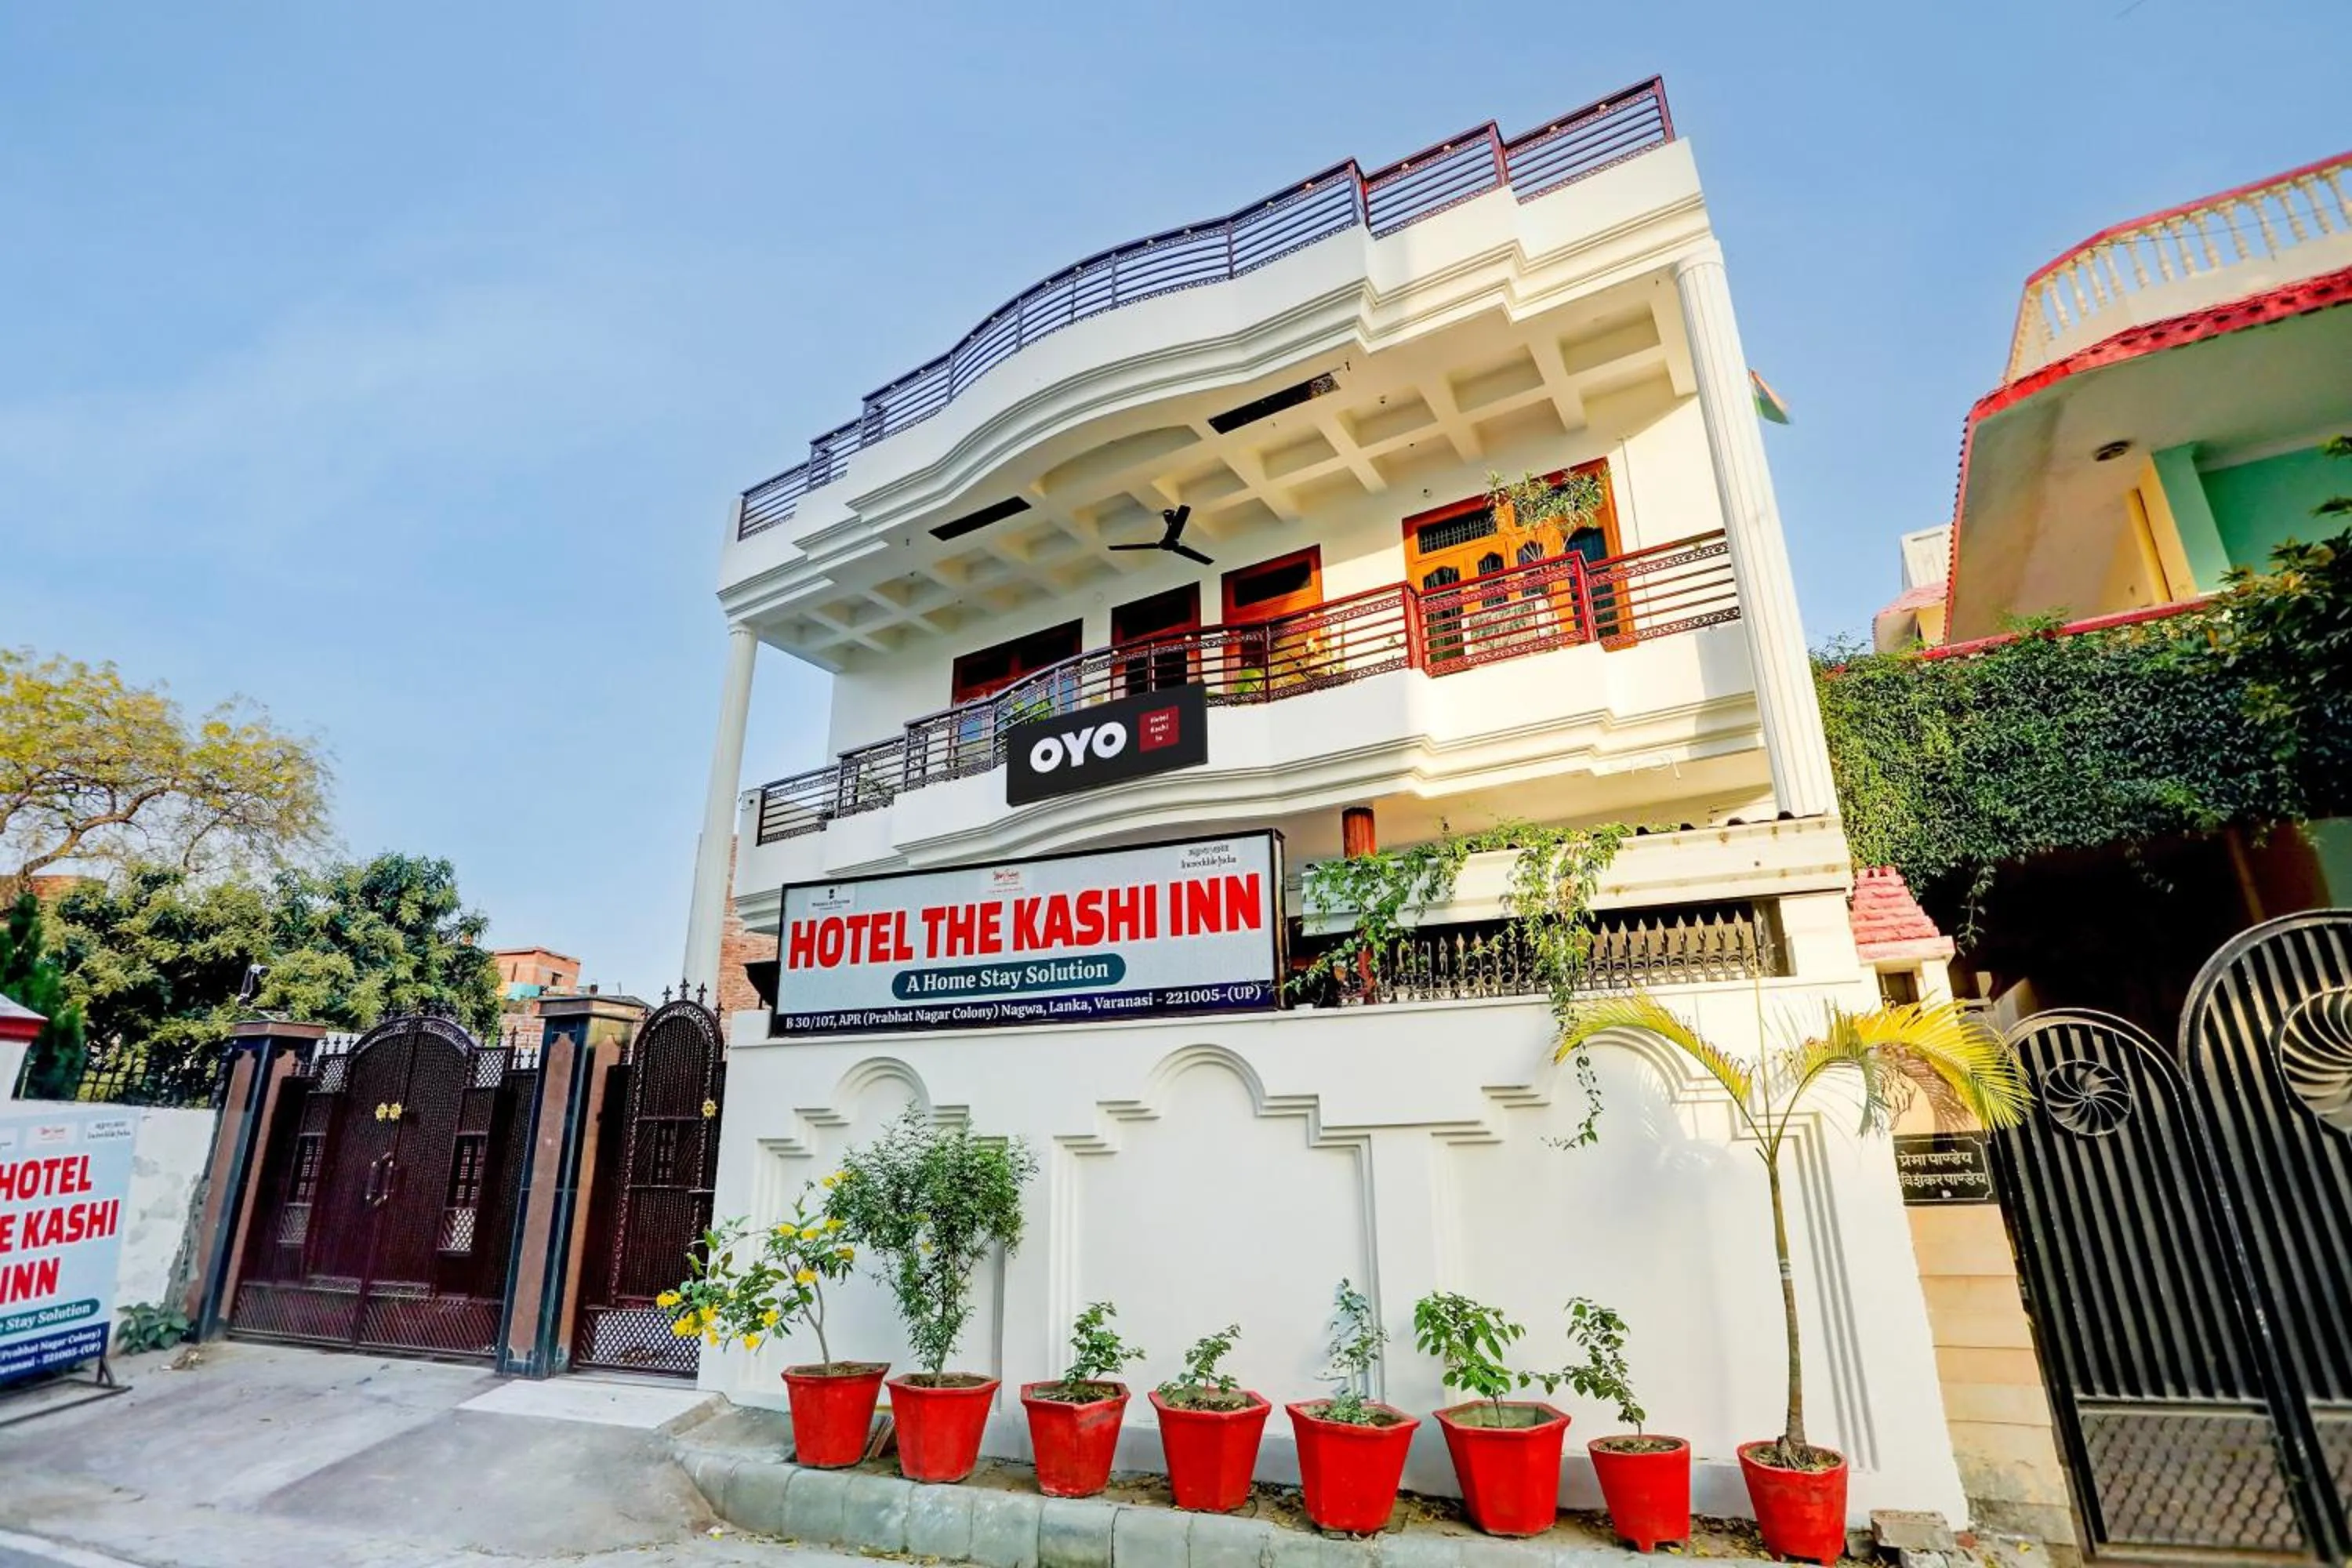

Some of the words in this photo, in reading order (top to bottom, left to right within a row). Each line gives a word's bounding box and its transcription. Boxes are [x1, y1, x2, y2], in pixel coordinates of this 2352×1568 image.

[1029, 721, 1127, 774] OYO
[788, 910, 913, 970] HOTEL
[921, 902, 1003, 959] THE
[1012, 884, 1157, 952] KASHI
[1169, 873, 1261, 937] INN
[905, 975, 921, 993] A
[923, 973, 976, 992] Home
[979, 970, 1022, 989] Stay
[1025, 960, 1109, 984] Solution
[786, 1017, 793, 1029] B
[838, 1013, 862, 1025] APR
[863, 1009, 913, 1026] (Prabhat
[915, 1009, 951, 1024] Nagar
[953, 1003, 999, 1020] Colony)
[1000, 1004, 1047, 1018] Nagwa,
[1049, 1000, 1093, 1013] Lanka,
[1094, 992, 1153, 1009] Varanasi
[0, 1155, 93, 1201] HOTEL
[21, 1199, 119, 1250] KASHI
[0, 1257, 60, 1305] INN
[5, 1316, 36, 1331] Stay
[37, 1304, 91, 1324] Solution
